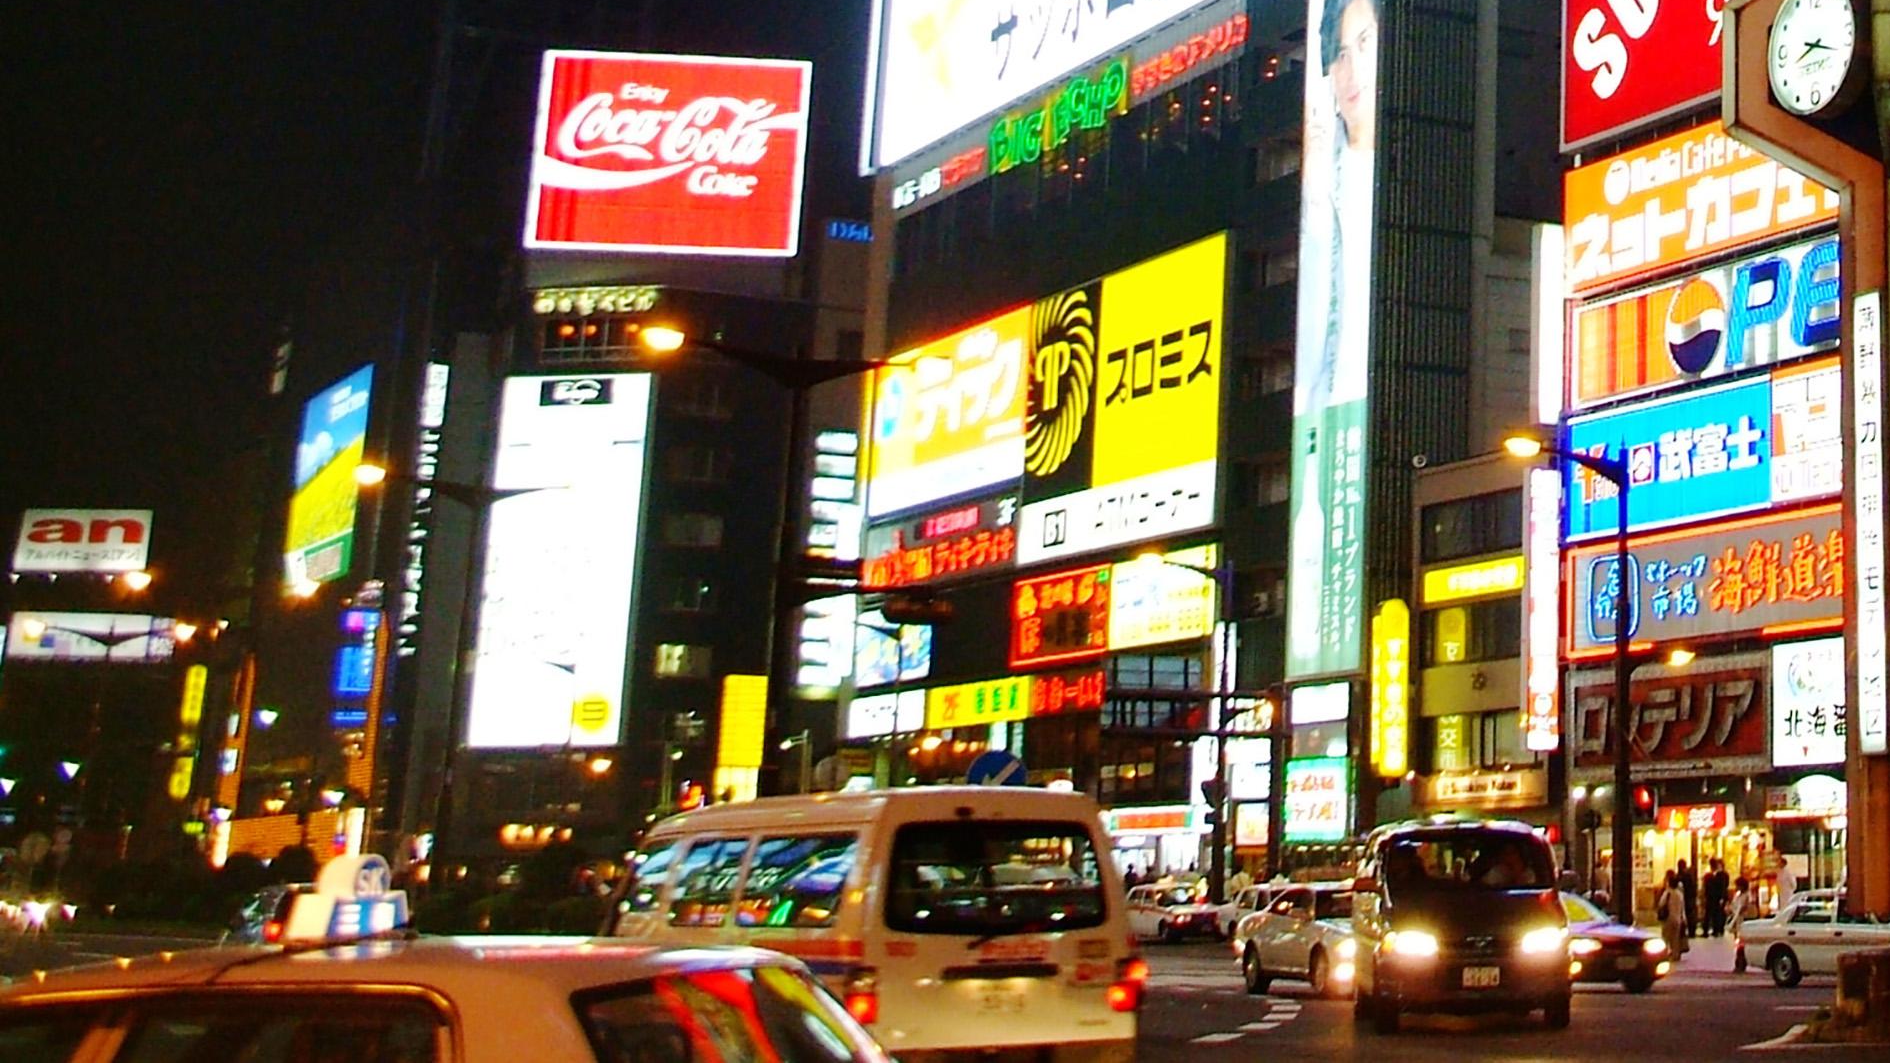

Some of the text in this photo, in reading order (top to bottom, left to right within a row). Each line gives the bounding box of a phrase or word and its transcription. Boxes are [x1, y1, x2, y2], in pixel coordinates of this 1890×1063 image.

[1777, 45, 1789, 68] 9
[1810, 81, 1822, 105] 6
[558, 92, 777, 165] Coca-Cola
[990, 110, 1045, 175] BIG
[1105, 319, 1213, 407] プロミス
[1659, 415, 1763, 483] 武富士
[27, 518, 144, 543] an
